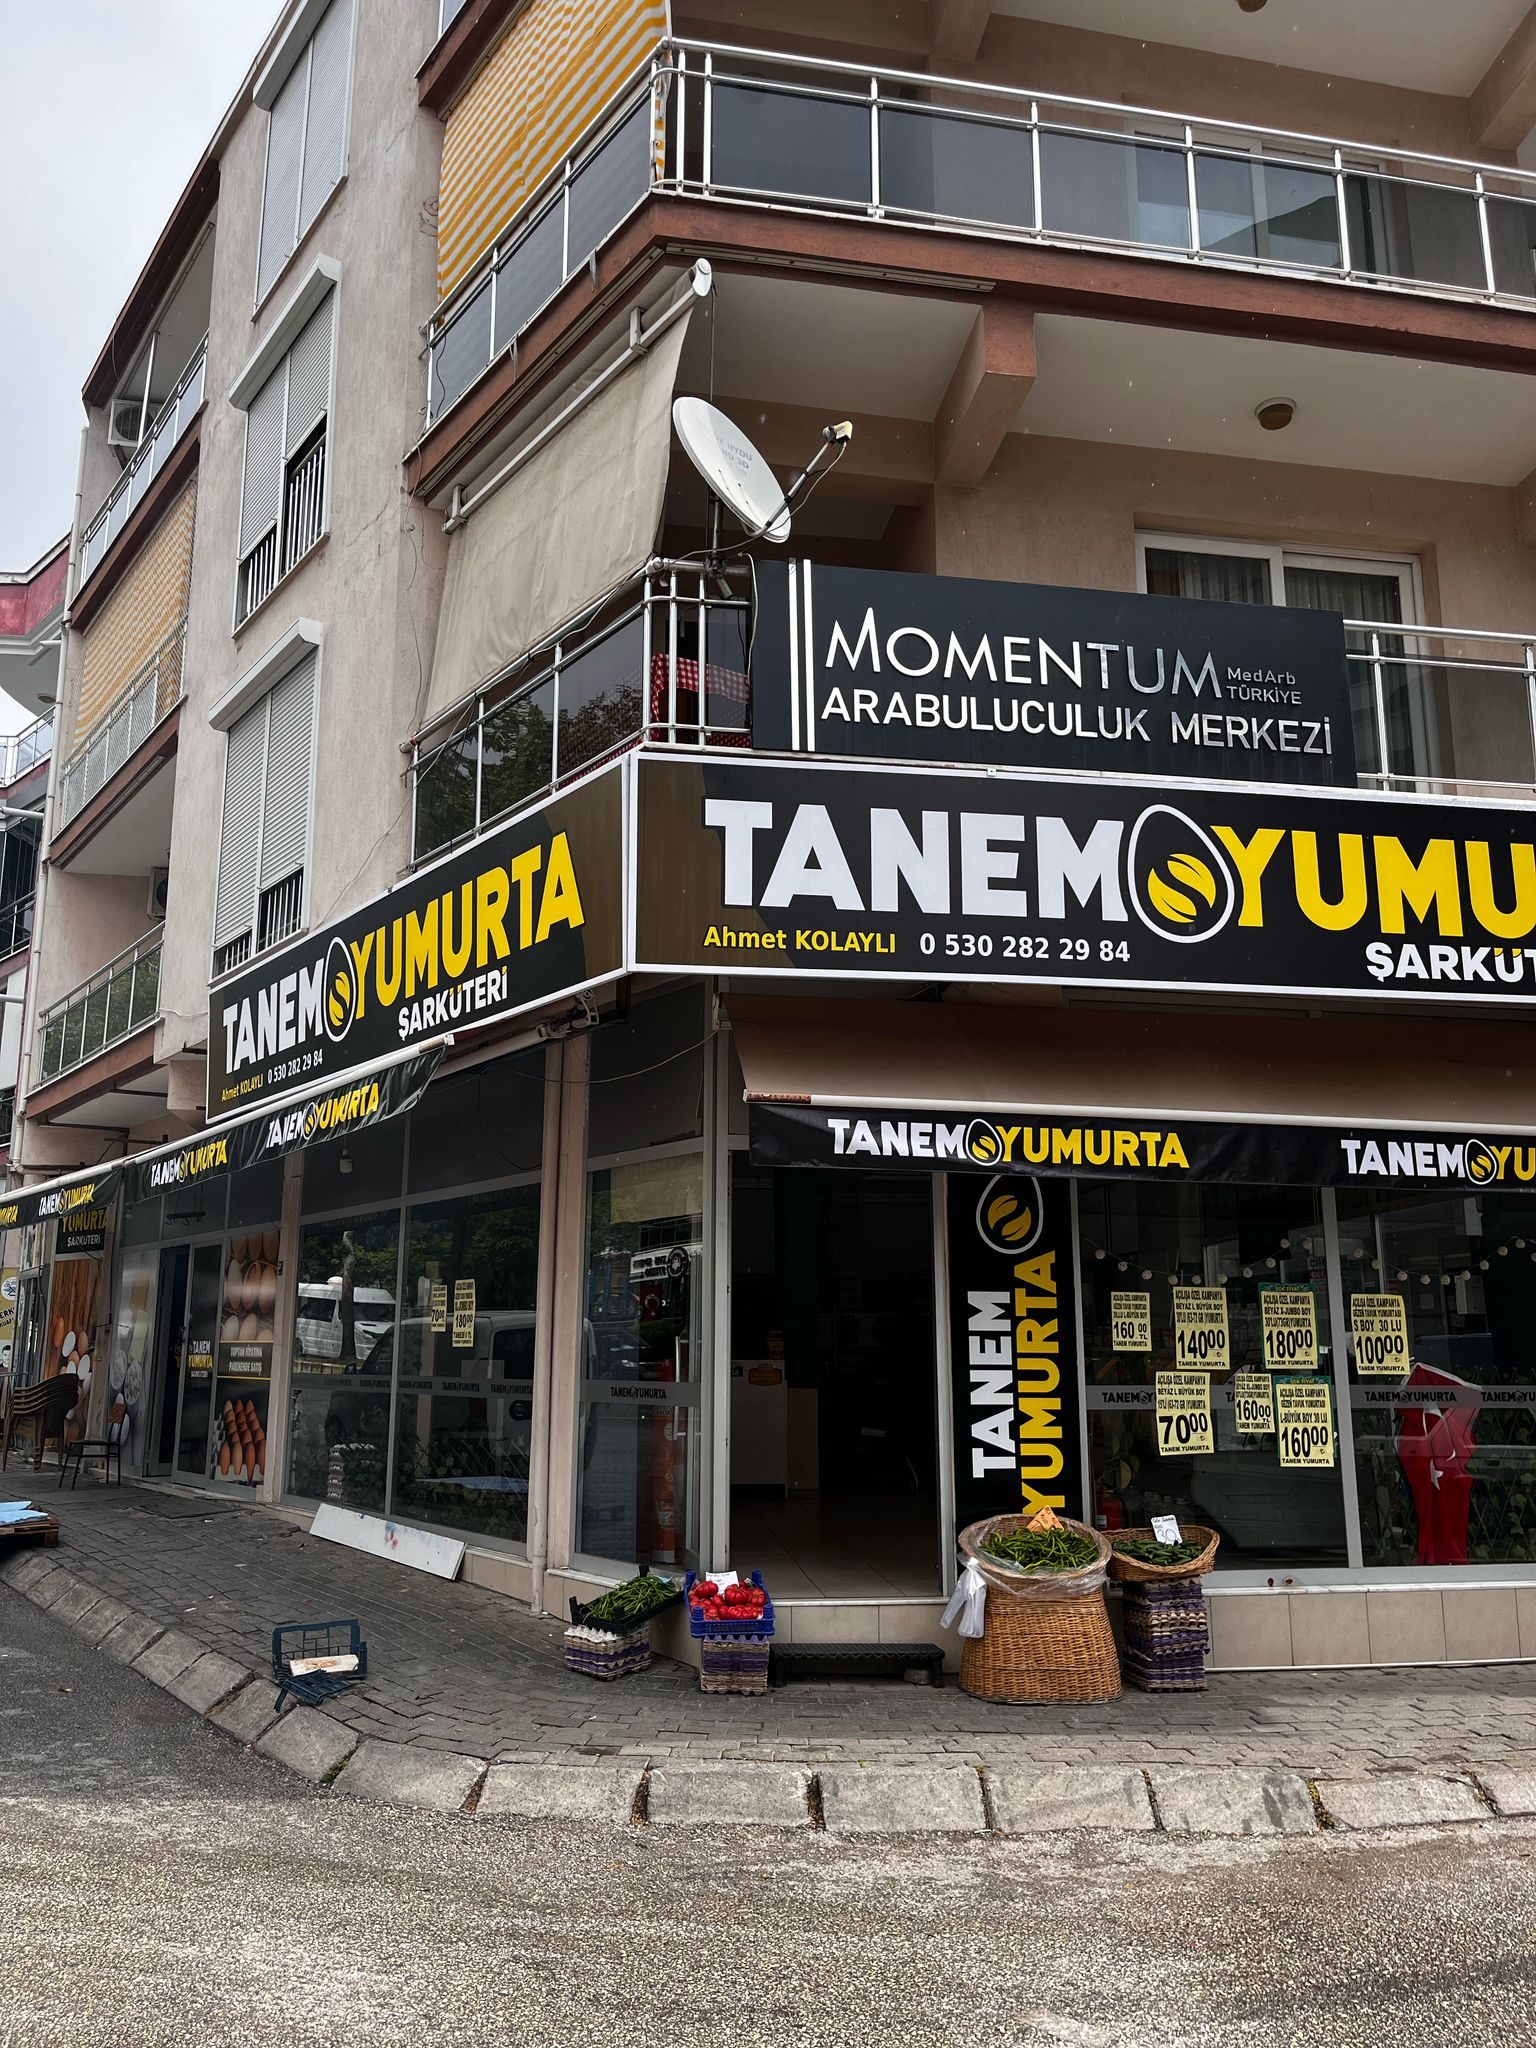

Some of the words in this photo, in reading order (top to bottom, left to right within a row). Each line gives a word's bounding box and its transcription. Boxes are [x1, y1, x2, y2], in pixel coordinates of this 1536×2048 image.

[825, 607, 1222, 699] MOMENTUM
[1225, 683, 1303, 705] TÜRKİYE
[1227, 667, 1297, 686] MedArb
[821, 686, 1151, 743] ARABULUCULUK
[1171, 711, 1333, 757] MERKEZİ
[704, 799, 1129, 923] TANEM
[223, 958, 325, 1075] TANEM
[349, 831, 585, 1020] YUMURTA
[703, 926, 787, 950] Ahmet
[795, 929, 898, 955] KOLAYLI
[919, 935, 936, 957] 0
[944, 936, 992, 959] 530
[1002, 936, 1050, 959] 282
[1058, 938, 1091, 961] 29
[1099, 940, 1131, 963] 84
[398, 966, 508, 1042] ŞARKÜTERİ
[221, 1086, 240, 1103] Ahmet
[240, 1073, 264, 1098] KOLAYLI
[273, 1066, 287, 1083] 530
[288, 1060, 301, 1078] 282
[303, 1055, 313, 1072] 29
[313, 1049, 323, 1067] 84
[266, 1111, 305, 1149] TANEM
[314, 1082, 380, 1130] YUMURTA
[828, 1118, 965, 1159] TANEM
[997, 1125, 1189, 1169] YUMURTA
[1341, 1138, 1465, 1178] TANEM
[151, 1158, 180, 1188] TANEM
[184, 1139, 228, 1178] YUMURTA
[39, 1193, 60, 1217] TANEM
[63, 1208, 108, 1233] YUMURTA
[1176, 1302, 1191, 1310] BEYAZ
[1354, 1319, 1359, 1332] S
[1360, 1320, 1374, 1332] BOY
[1379, 1320, 1388, 1332] 30
[1391, 1320, 1401, 1332] LU
[189, 1355, 213, 1368] YUMURTA
[193, 1341, 211, 1354] TANEM
[610, 1387, 632, 1398] TANEM
[635, 1388, 666, 1399] YUMURTA
[968, 1290, 1017, 1478] TANEM
[1014, 1250, 1066, 1515] YUMURTA
[1102, 1392, 1137, 1402] TANEM
[1365, 1391, 1399, 1402] TANEM
[1408, 1391, 1456, 1402] YUMURTA
[1482, 1391, 1514, 1402] TANEM
